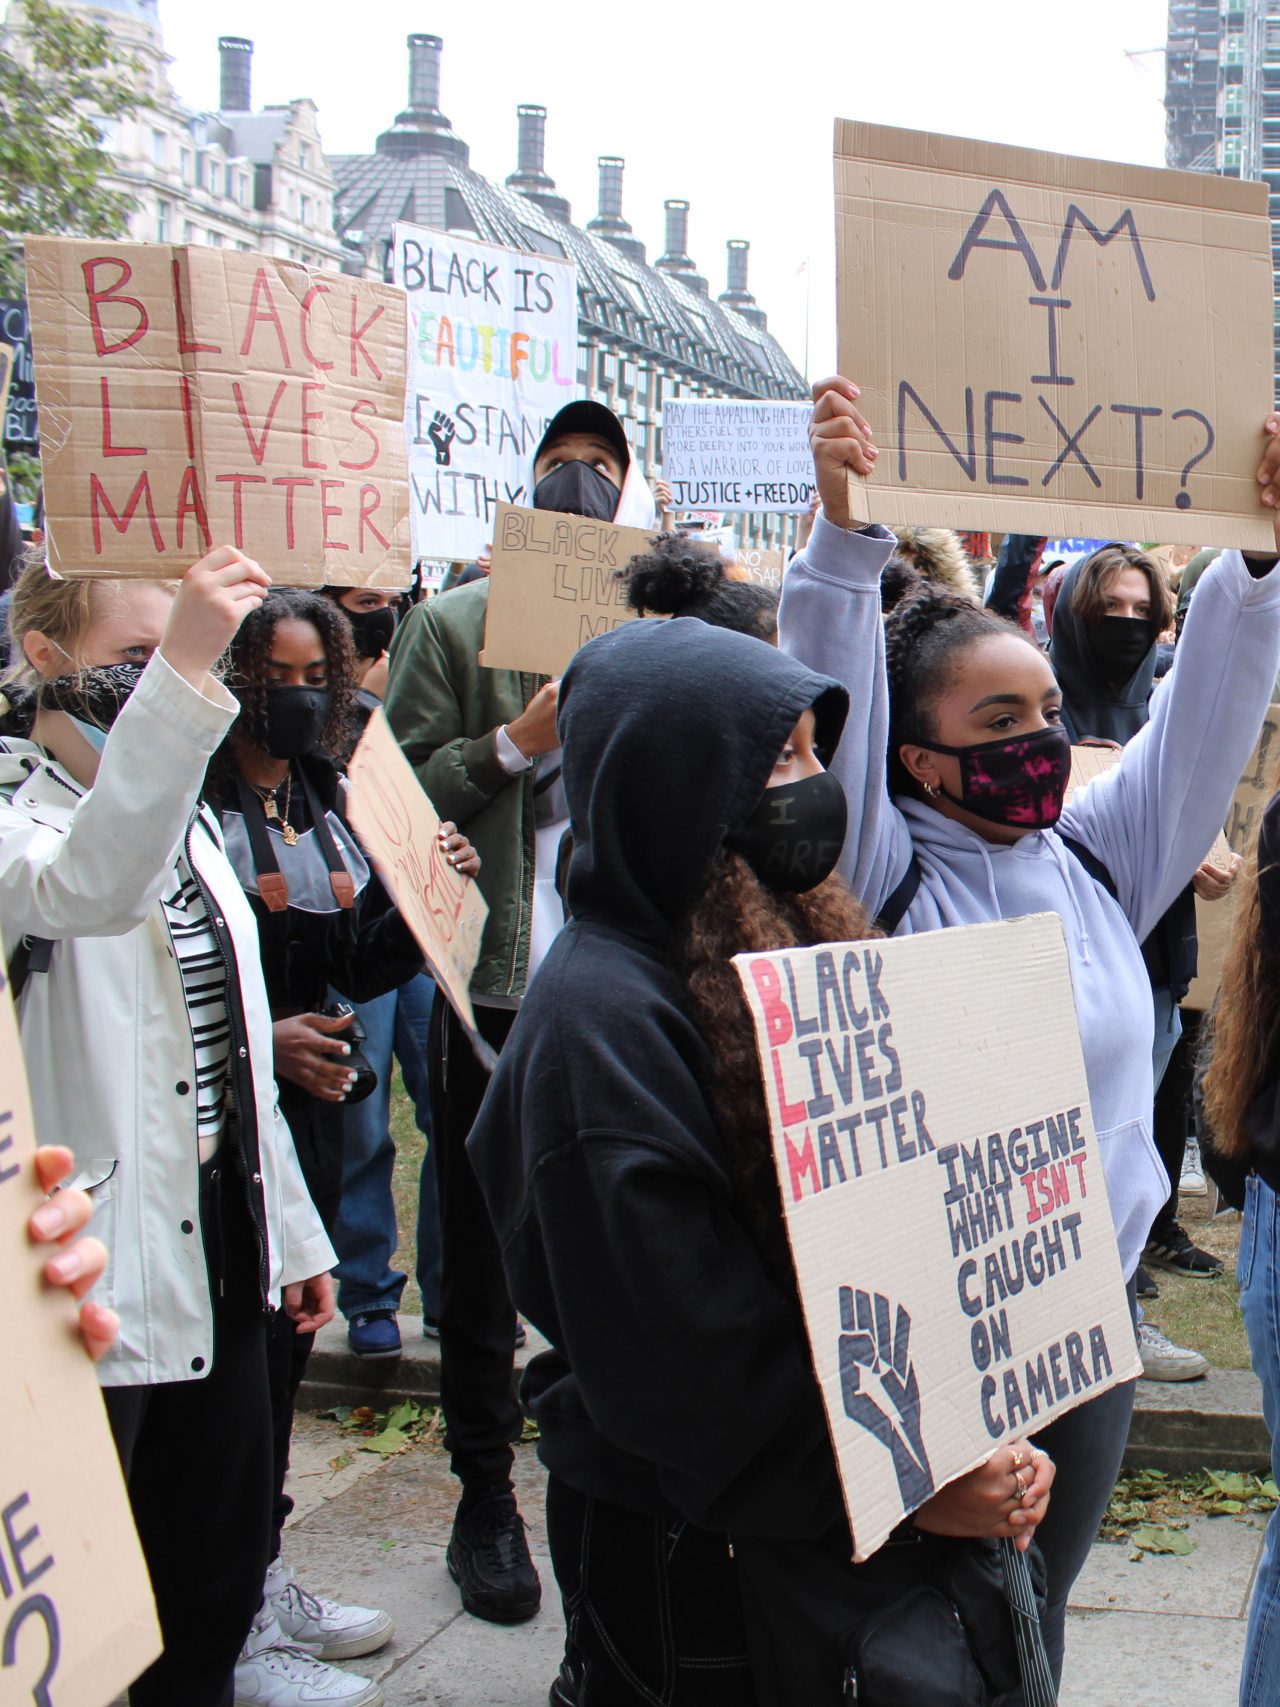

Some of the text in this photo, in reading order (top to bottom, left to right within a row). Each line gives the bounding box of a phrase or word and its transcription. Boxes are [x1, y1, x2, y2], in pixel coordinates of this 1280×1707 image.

[403, 239, 555, 313] BLACK IS
[947, 188, 1156, 302] AM
[81, 256, 385, 380] BLACK
[1028, 296, 1076, 386] I
[101, 375, 380, 471] LIVES
[412, 394, 432, 445] I
[665, 402, 688, 425] MAY
[692, 403, 713, 425] THE
[715, 404, 771, 425] APPALLING
[772, 406, 799, 425] HATE
[665, 425, 799, 439] OTHERS FUEL YOU TO STEP
[667, 440, 696, 454] MORE
[700, 440, 733, 452] DEEPLY
[737, 440, 758, 451] INTO
[761, 441, 785, 453] YOUR
[898, 379, 1216, 510] NEXT?
[89, 465, 391, 555] MATTER
[411, 470, 499, 523] WITH
[668, 456, 684, 477] AS
[688, 457, 697, 477] A
[700, 456, 762, 477] WARRIOR
[767, 459, 782, 475] OF
[672, 481, 742, 505] JUSTICE
[754, 482, 817, 505] FREEDOM
[502, 512, 619, 566] BLACK
[554, 564, 630, 606] LIVE
[768, 796, 797, 825] I
[749, 948, 891, 1047] BLACK
[771, 1022, 903, 1128] LIVES
[784, 1089, 938, 1203] MATTER
[936, 1107, 1086, 1205] IMAGINE
[945, 1152, 1088, 1258] WHAT ISN'T
[957, 1211, 1082, 1318] CAUGHT
[970, 1308, 1013, 1372] ON
[980, 1323, 1113, 1439] CAMERA
